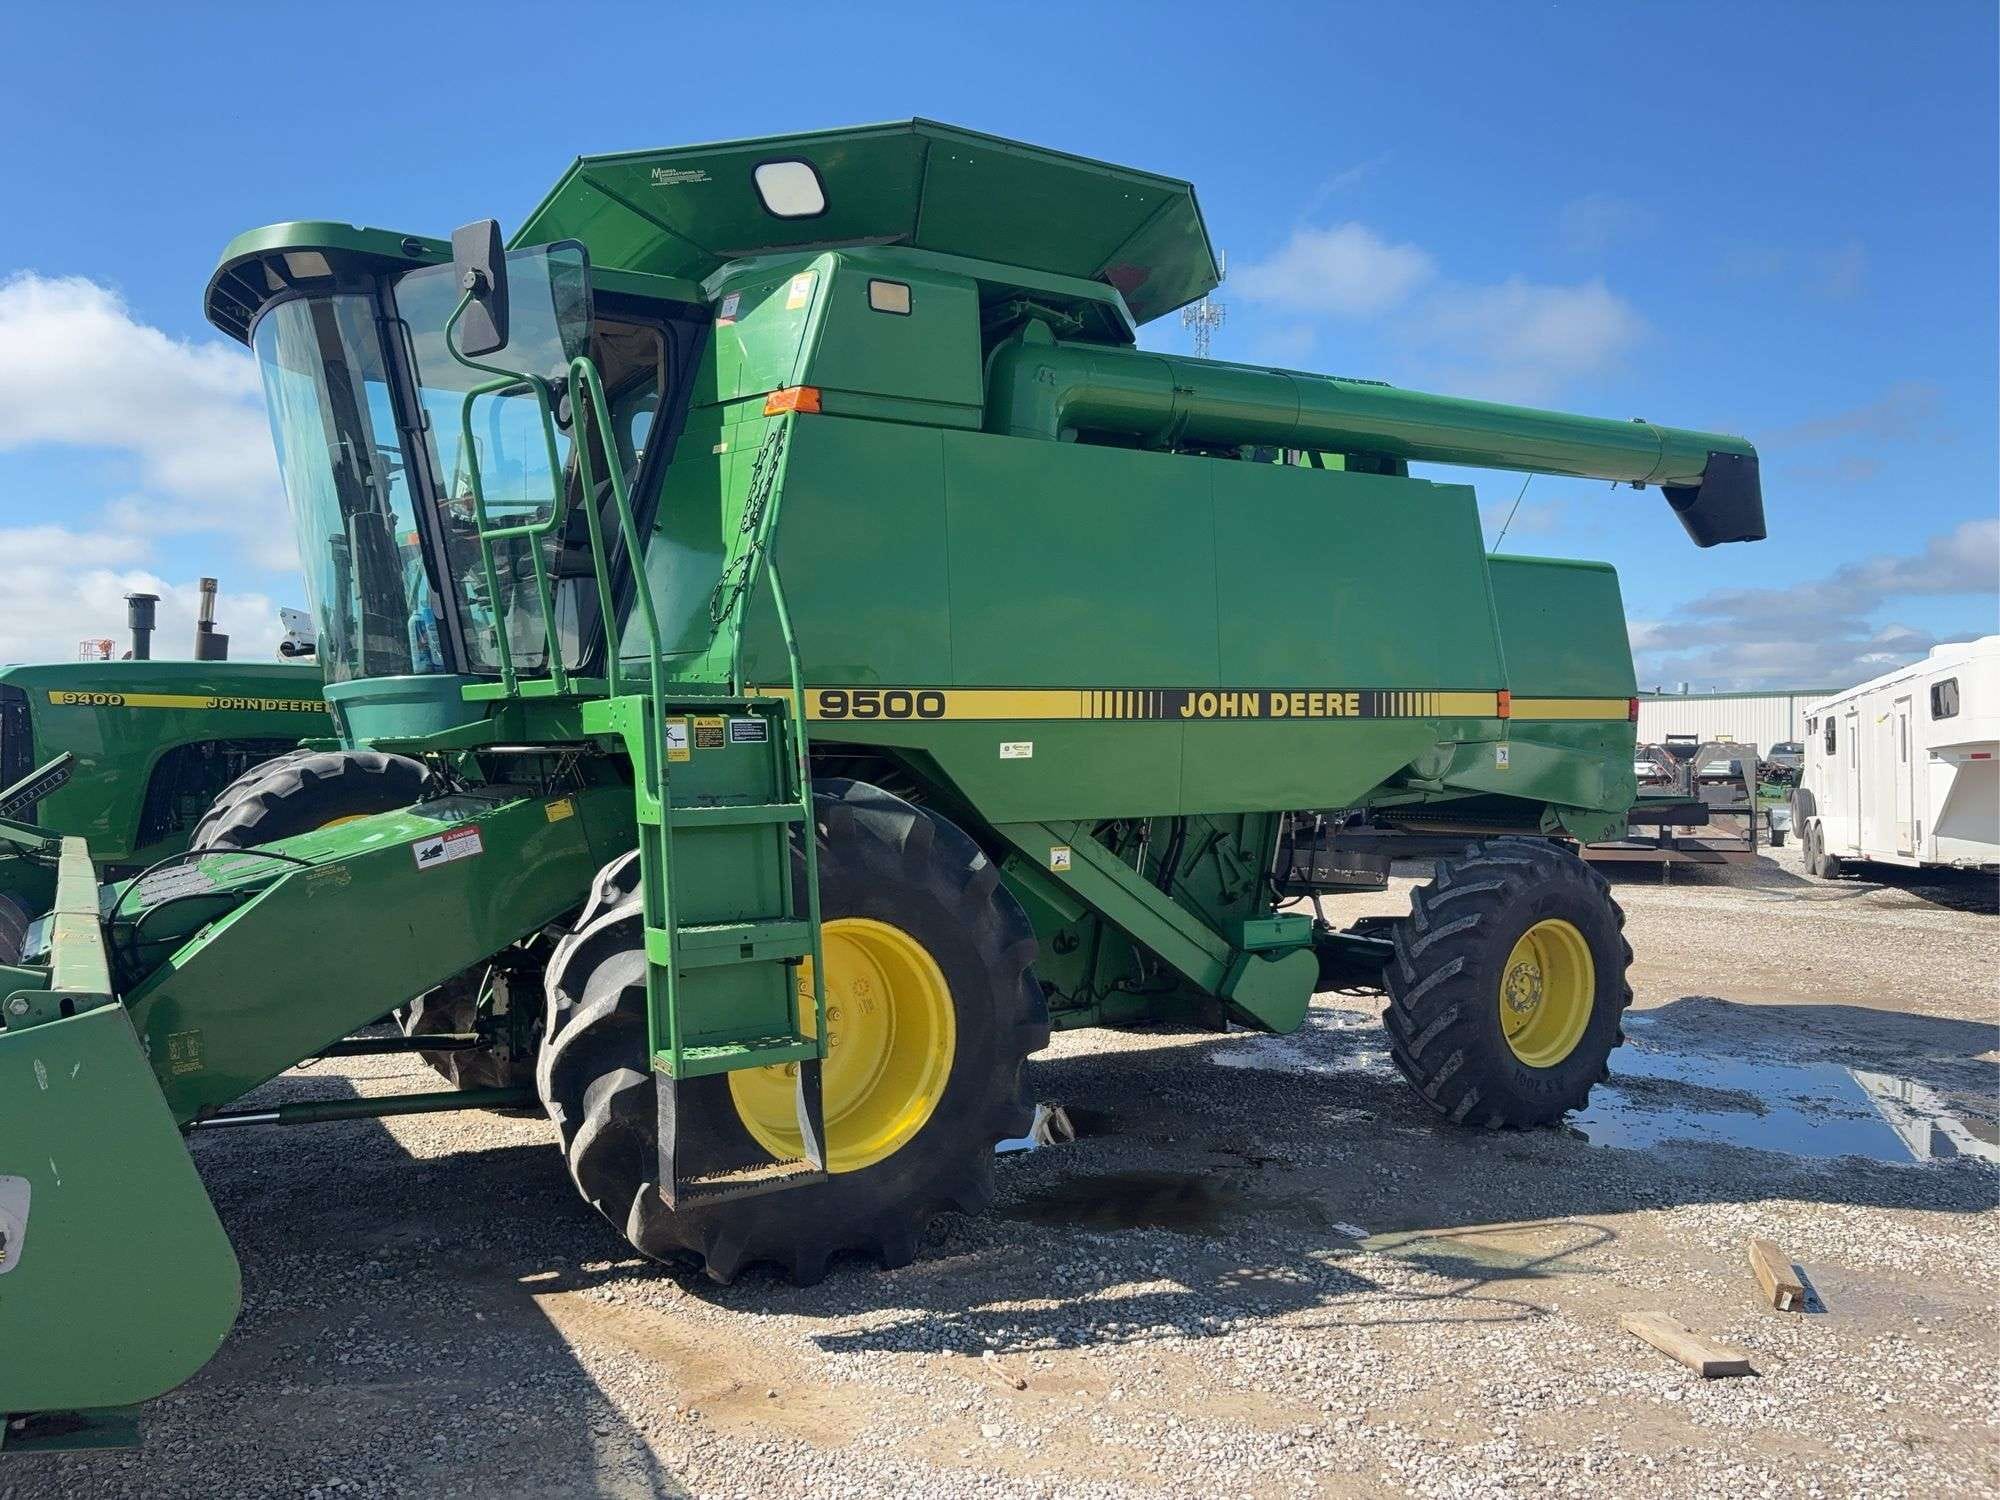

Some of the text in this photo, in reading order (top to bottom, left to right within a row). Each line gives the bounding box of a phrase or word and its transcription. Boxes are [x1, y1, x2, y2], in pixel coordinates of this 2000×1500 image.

[63, 693, 122, 705] 9400
[207, 698, 325, 712] JOHN DEERE
[819, 690, 946, 718] 9500
[1180, 692, 1360, 717] JOHN DEERE
